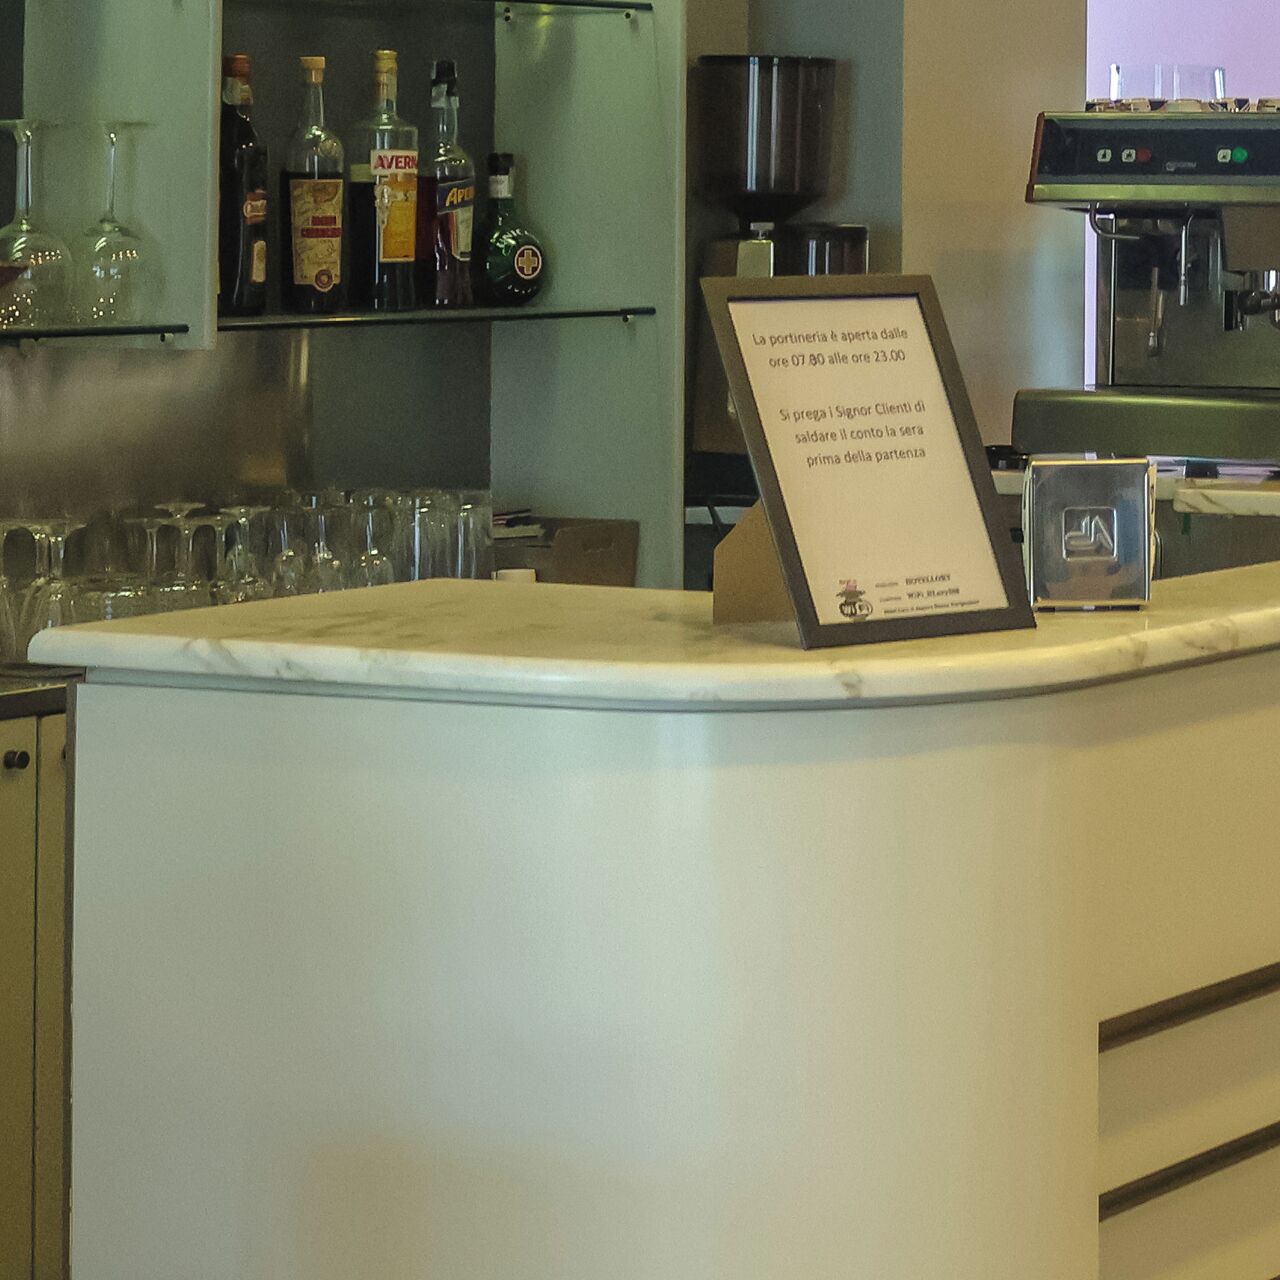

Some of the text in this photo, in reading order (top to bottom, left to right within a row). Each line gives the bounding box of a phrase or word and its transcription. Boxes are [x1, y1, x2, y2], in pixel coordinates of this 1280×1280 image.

[752, 333, 766, 345] La
[769, 331, 828, 347] portineria
[841, 328, 878, 343] aperta
[880, 327, 908, 340] dalle
[769, 356, 789, 368] ore
[828, 351, 849, 365] alle
[851, 352, 871, 364] ore
[874, 349, 906, 363] 23.00
[779, 408, 791, 421] Si
[793, 408, 827, 423] prega
[874, 400, 912, 416] Clienti
[914, 400, 926, 413] di
[795, 424, 924, 445] saldare il conto la sera
[806, 447, 926, 468] prima della partenza
